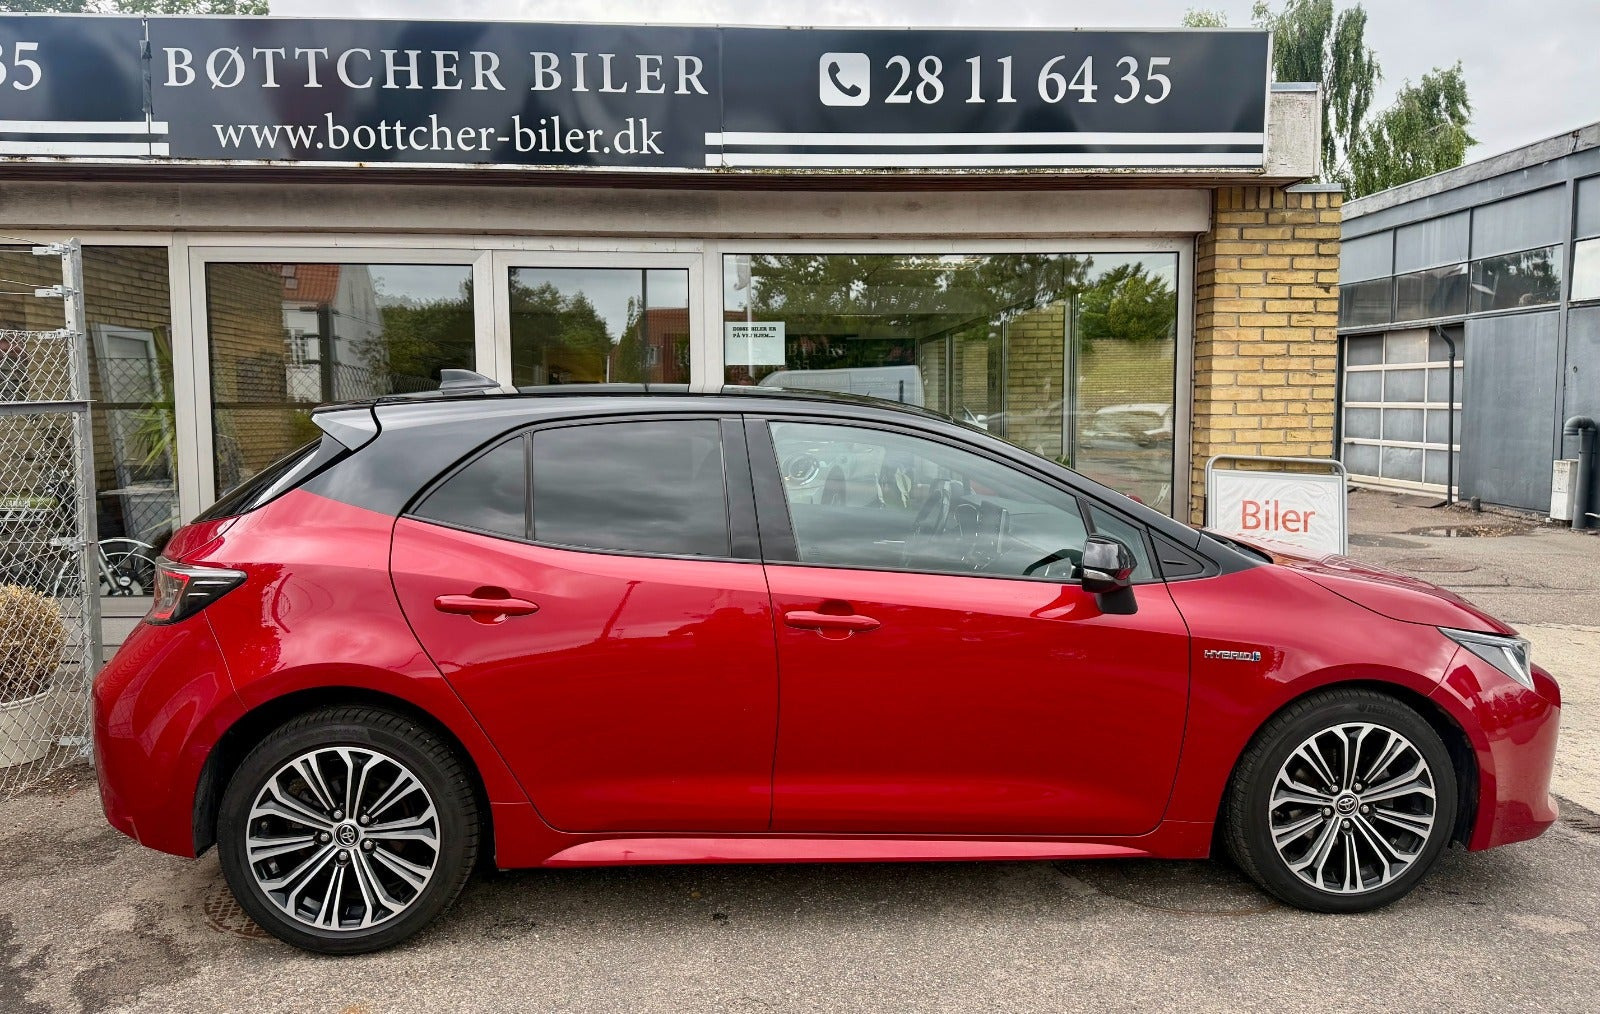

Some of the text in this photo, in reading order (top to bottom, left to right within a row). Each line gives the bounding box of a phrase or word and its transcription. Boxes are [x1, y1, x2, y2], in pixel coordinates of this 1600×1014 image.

[162, 46, 709, 95] BØTTCHER BILER
[884, 54, 1172, 105] 28 11 64 35
[212, 111, 665, 156] www.bottcher-biler.dk
[1241, 500, 1316, 533] Biler
[1203, 650, 1252, 661] HYBRID
